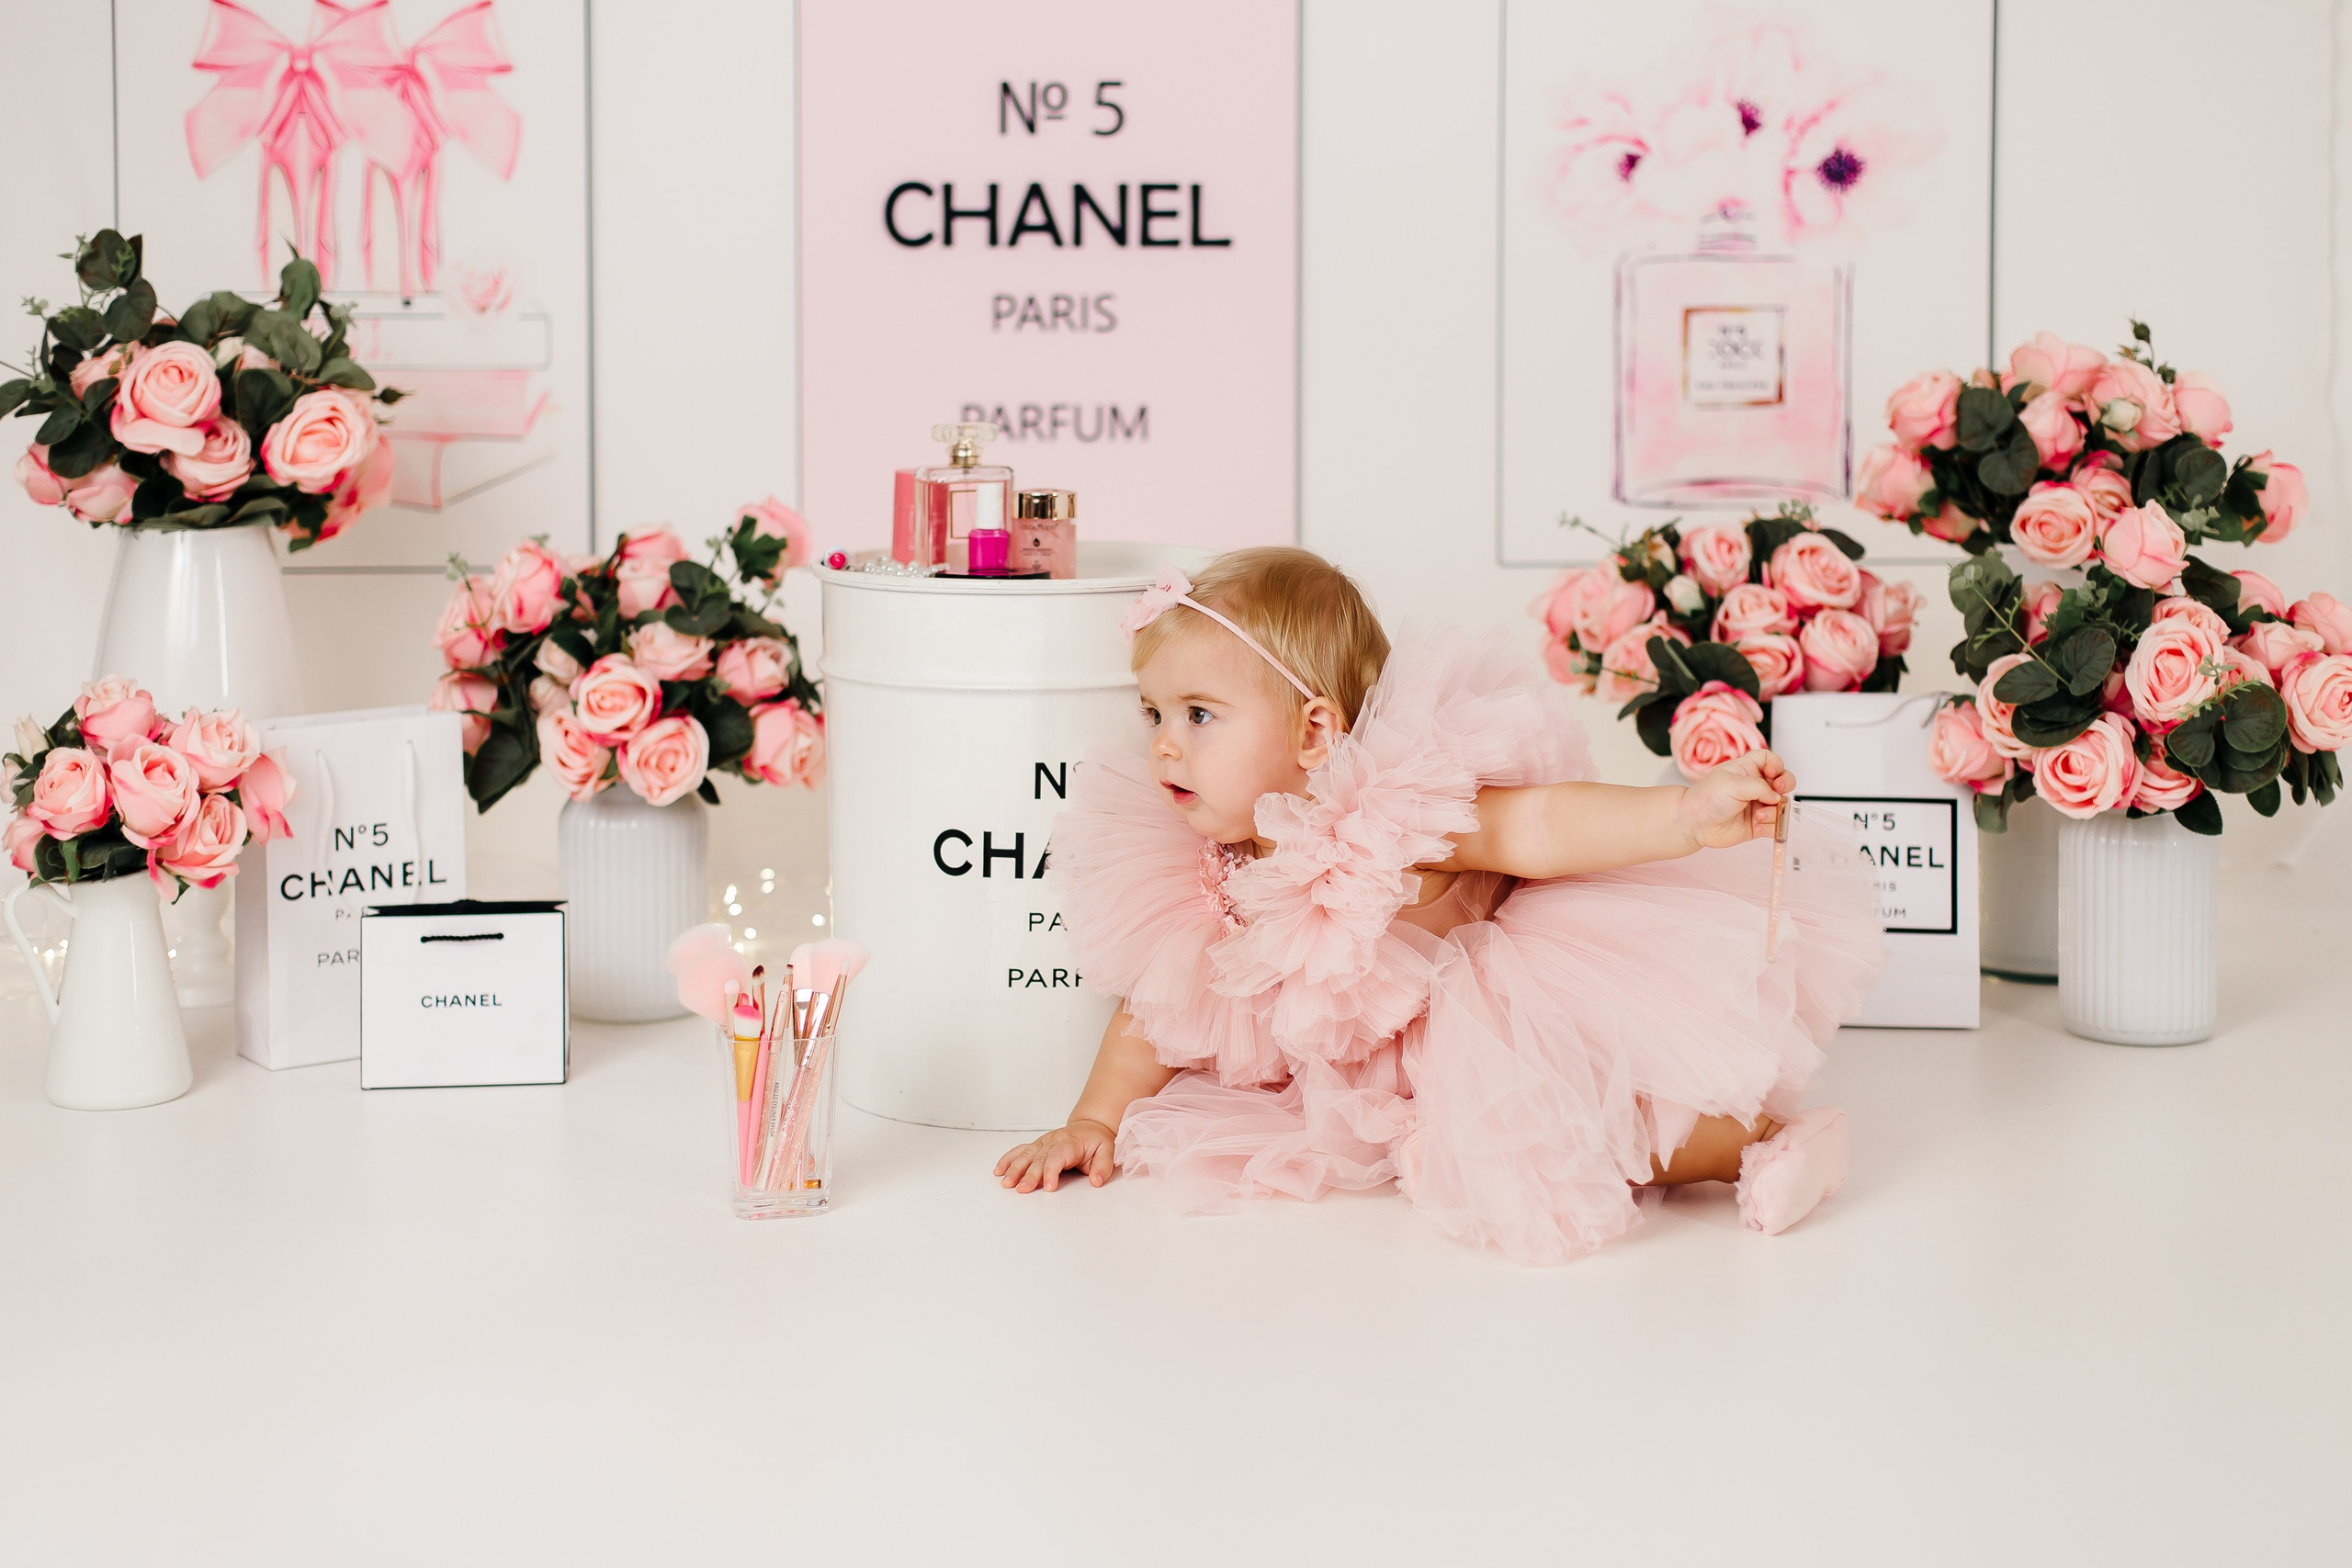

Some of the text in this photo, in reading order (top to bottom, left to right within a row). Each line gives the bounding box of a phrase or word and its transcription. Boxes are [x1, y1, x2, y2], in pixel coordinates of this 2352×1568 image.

[1091, 80, 1125, 136] 5
[885, 181, 1233, 248] CHANEL
[991, 292, 1118, 334] PARIS
[280, 859, 447, 901] CHANEL
[317, 950, 359, 967] PAR
[421, 994, 503, 1009] CHANEL
